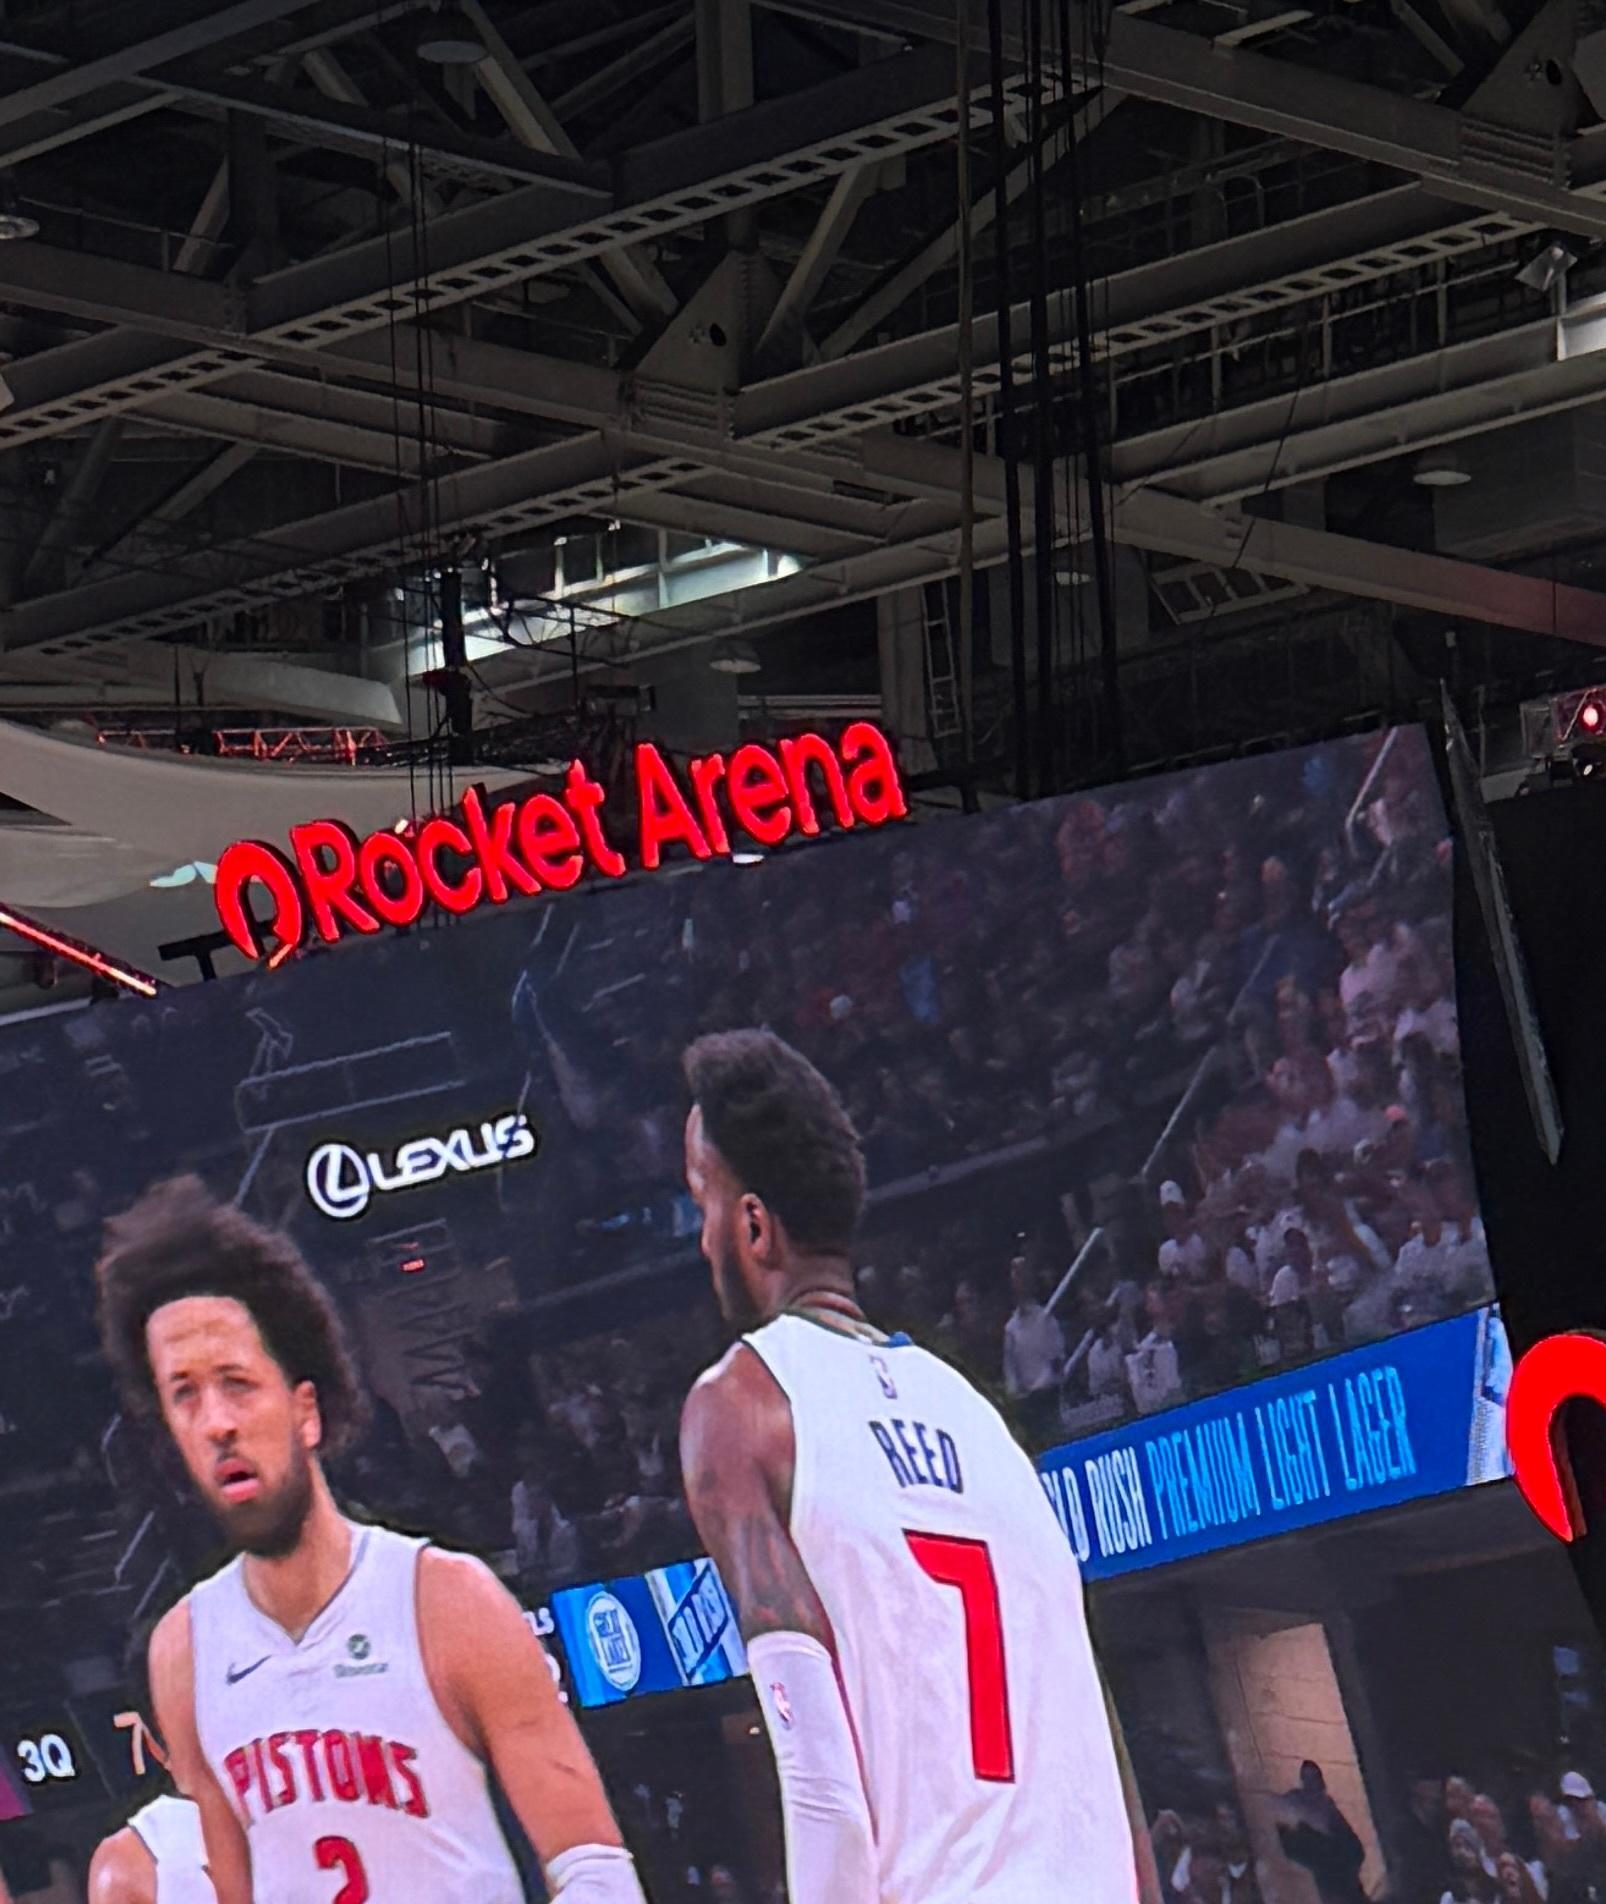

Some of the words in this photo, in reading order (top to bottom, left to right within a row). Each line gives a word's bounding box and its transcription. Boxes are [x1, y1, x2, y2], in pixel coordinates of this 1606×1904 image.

[290, 758, 628, 946] Rocket
[635, 719, 903, 871] Arena
[369, 1113, 537, 1191] LEXUS
[868, 1418, 965, 1495] REED
[1084, 1446, 1152, 1558] RUSH
[1145, 1411, 1261, 1541] PREMIUM
[1254, 1389, 1330, 1511] LIGHT
[1328, 1365, 1417, 1490] LAGER
[903, 1527, 1015, 1786] 7
[16, 1733, 77, 1784] 3Q
[222, 1728, 430, 1819] PISTONS
